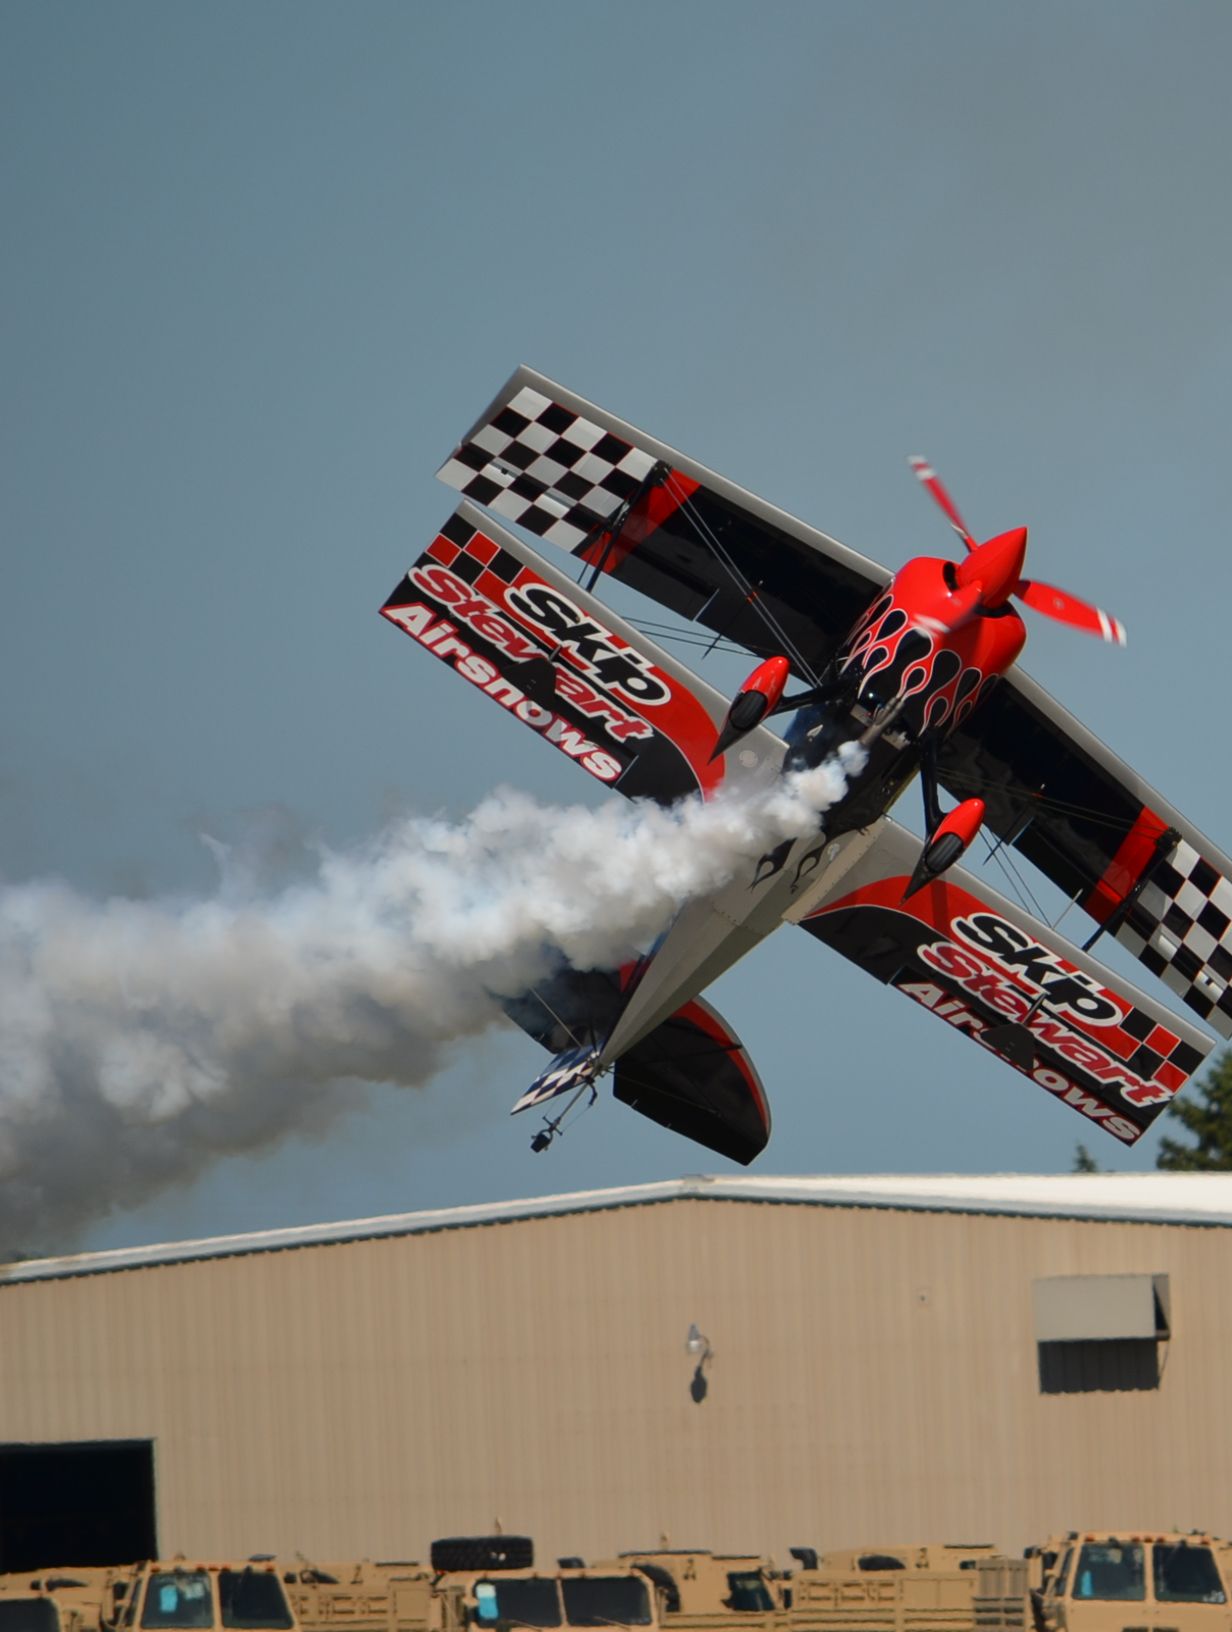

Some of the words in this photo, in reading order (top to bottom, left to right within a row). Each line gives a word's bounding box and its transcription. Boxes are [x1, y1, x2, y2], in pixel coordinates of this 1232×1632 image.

[504, 583, 671, 705] Skip
[917, 942, 1172, 1108] Stewart
[951, 913, 1123, 1027] Skip
[897, 982, 1140, 1142] Airows
